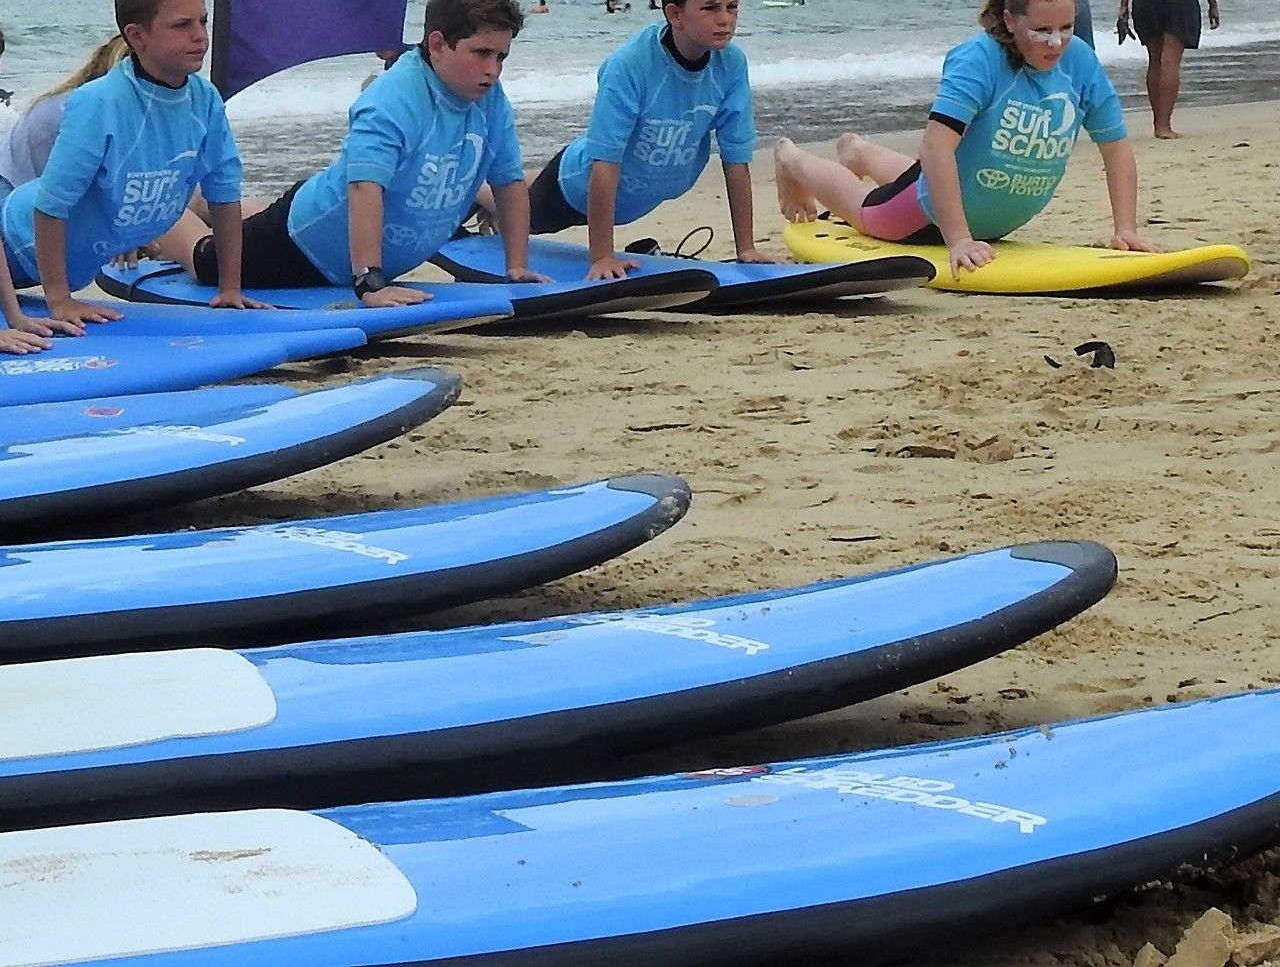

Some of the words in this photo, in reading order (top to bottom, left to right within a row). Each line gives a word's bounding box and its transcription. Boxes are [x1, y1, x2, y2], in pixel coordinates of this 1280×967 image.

[632, 140, 697, 167] scho
[991, 128, 1076, 160] school
[1011, 173, 1058, 187] BURTO
